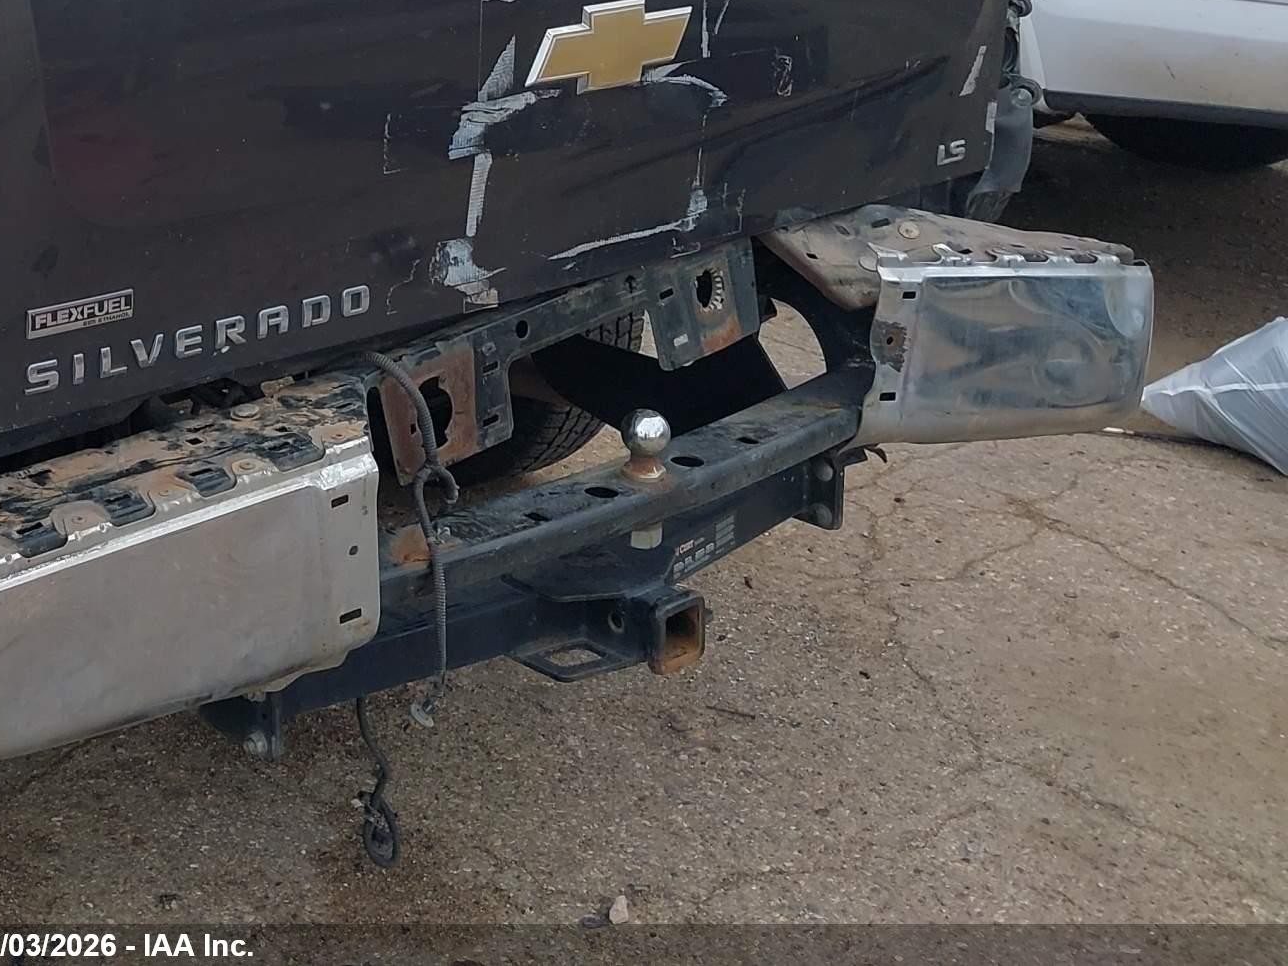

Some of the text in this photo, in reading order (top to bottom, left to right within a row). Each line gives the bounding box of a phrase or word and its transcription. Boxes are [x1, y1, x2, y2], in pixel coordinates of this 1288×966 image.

[936, 139, 966, 166] LS
[35, 296, 131, 329] FLEXFUEL
[24, 285, 370, 395] SILVERADO
